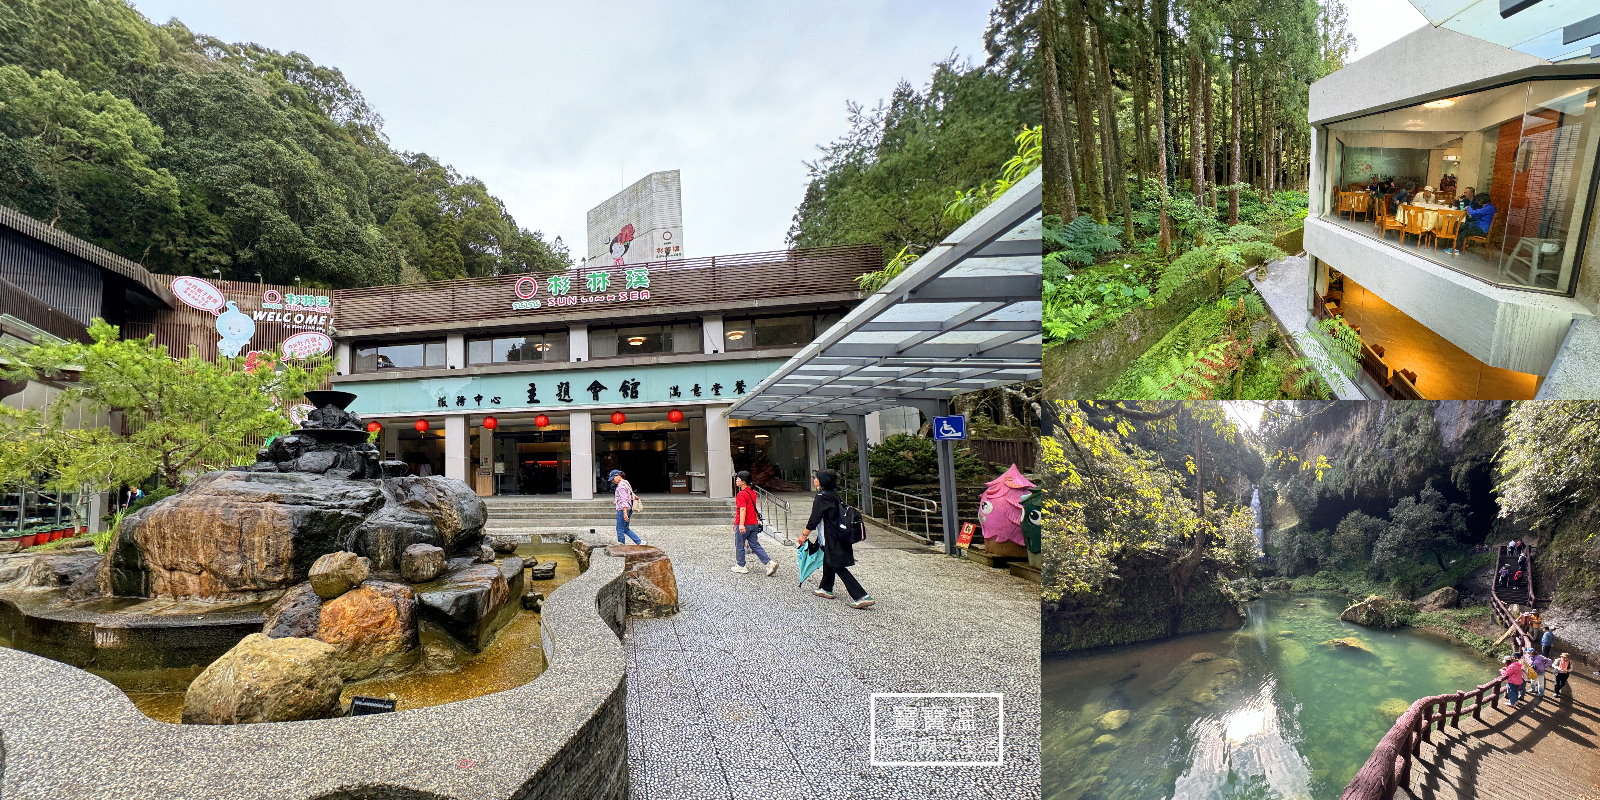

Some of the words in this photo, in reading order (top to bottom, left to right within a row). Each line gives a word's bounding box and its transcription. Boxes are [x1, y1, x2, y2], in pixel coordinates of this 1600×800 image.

[547, 268, 650, 296] 杉林溪
[285, 293, 331, 308] 杉林溪
[285, 303, 301, 311] SUN
[547, 296, 578, 307] SUN
[618, 290, 650, 301] SEA
[526, 378, 641, 404] 主題會館
[669, 379, 764, 398] 滿意堂餐
[437, 393, 501, 408] 服務中心
